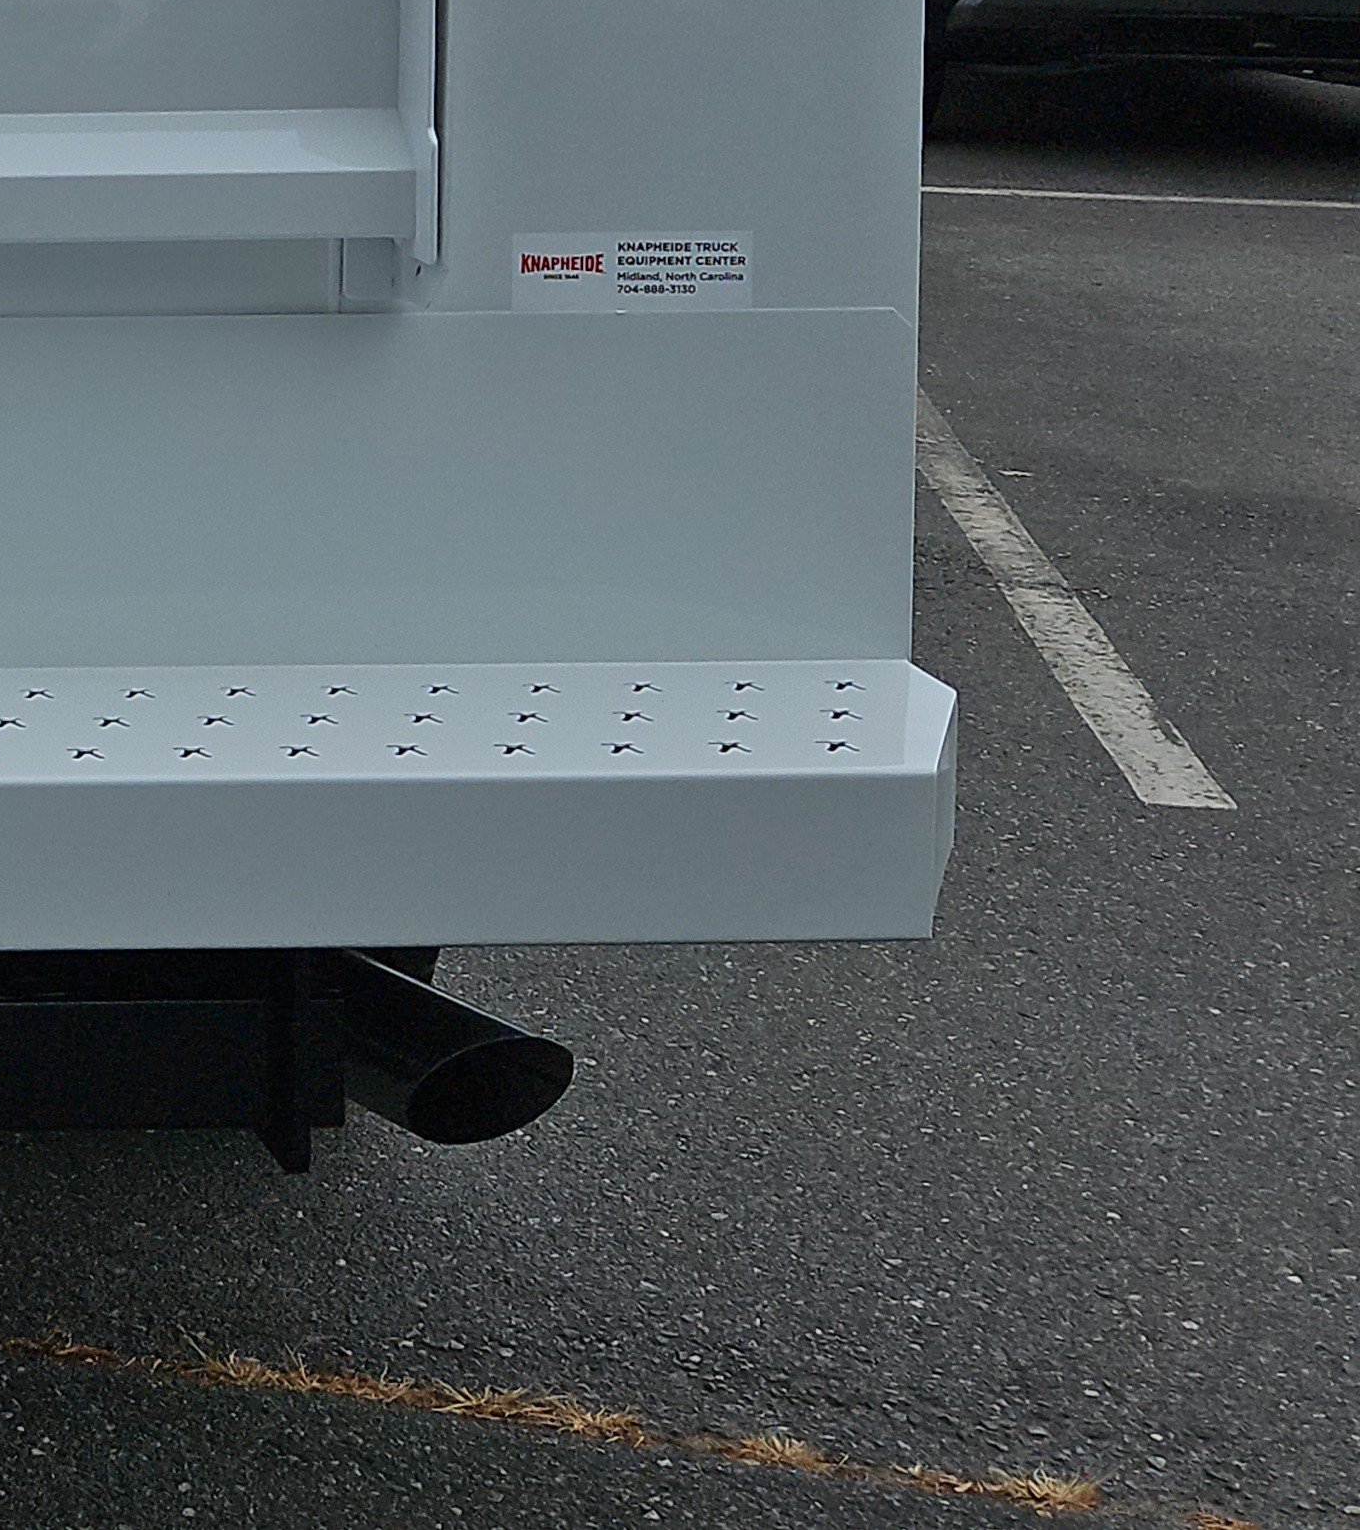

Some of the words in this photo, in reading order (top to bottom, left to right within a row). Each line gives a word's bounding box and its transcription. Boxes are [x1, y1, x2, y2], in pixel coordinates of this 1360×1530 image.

[617, 242, 692, 252] KNAPHEIDE
[695, 242, 739, 252] TRUCK
[521, 253, 605, 274] KNAPHEIDE
[617, 256, 692, 266] EQUIPMENT
[695, 256, 747, 266] CENTER
[617, 272, 663, 282] Midland,
[665, 272, 697, 281] North
[699, 272, 744, 281] Carolina
[616, 284, 697, 294] 704-888-3130
